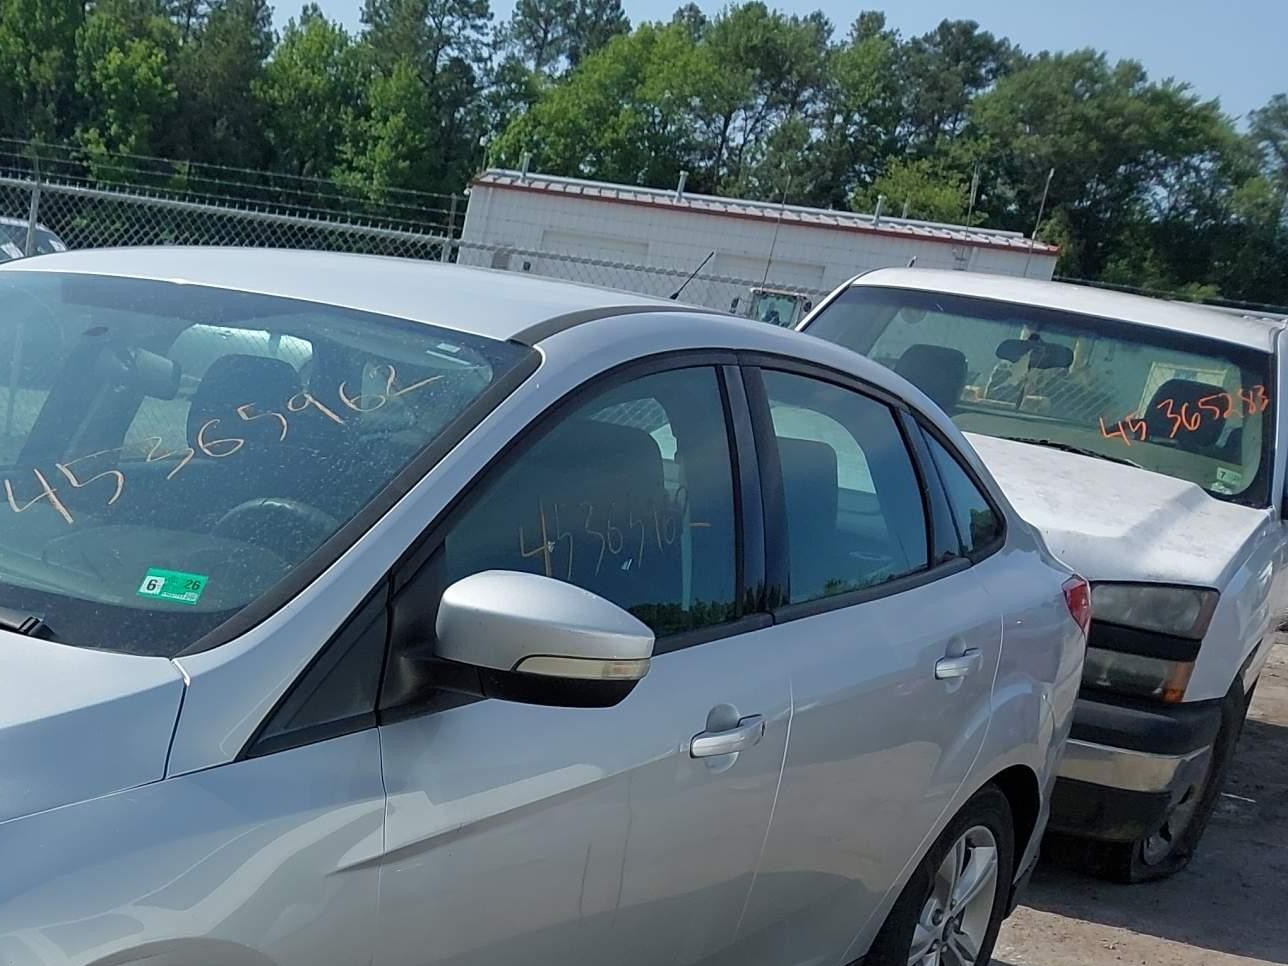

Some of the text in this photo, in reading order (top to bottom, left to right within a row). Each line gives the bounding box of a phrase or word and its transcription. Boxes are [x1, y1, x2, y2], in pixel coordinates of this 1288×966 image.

[4, 364, 445, 525] 45365962
[145, 578, 201, 592] 6 26
